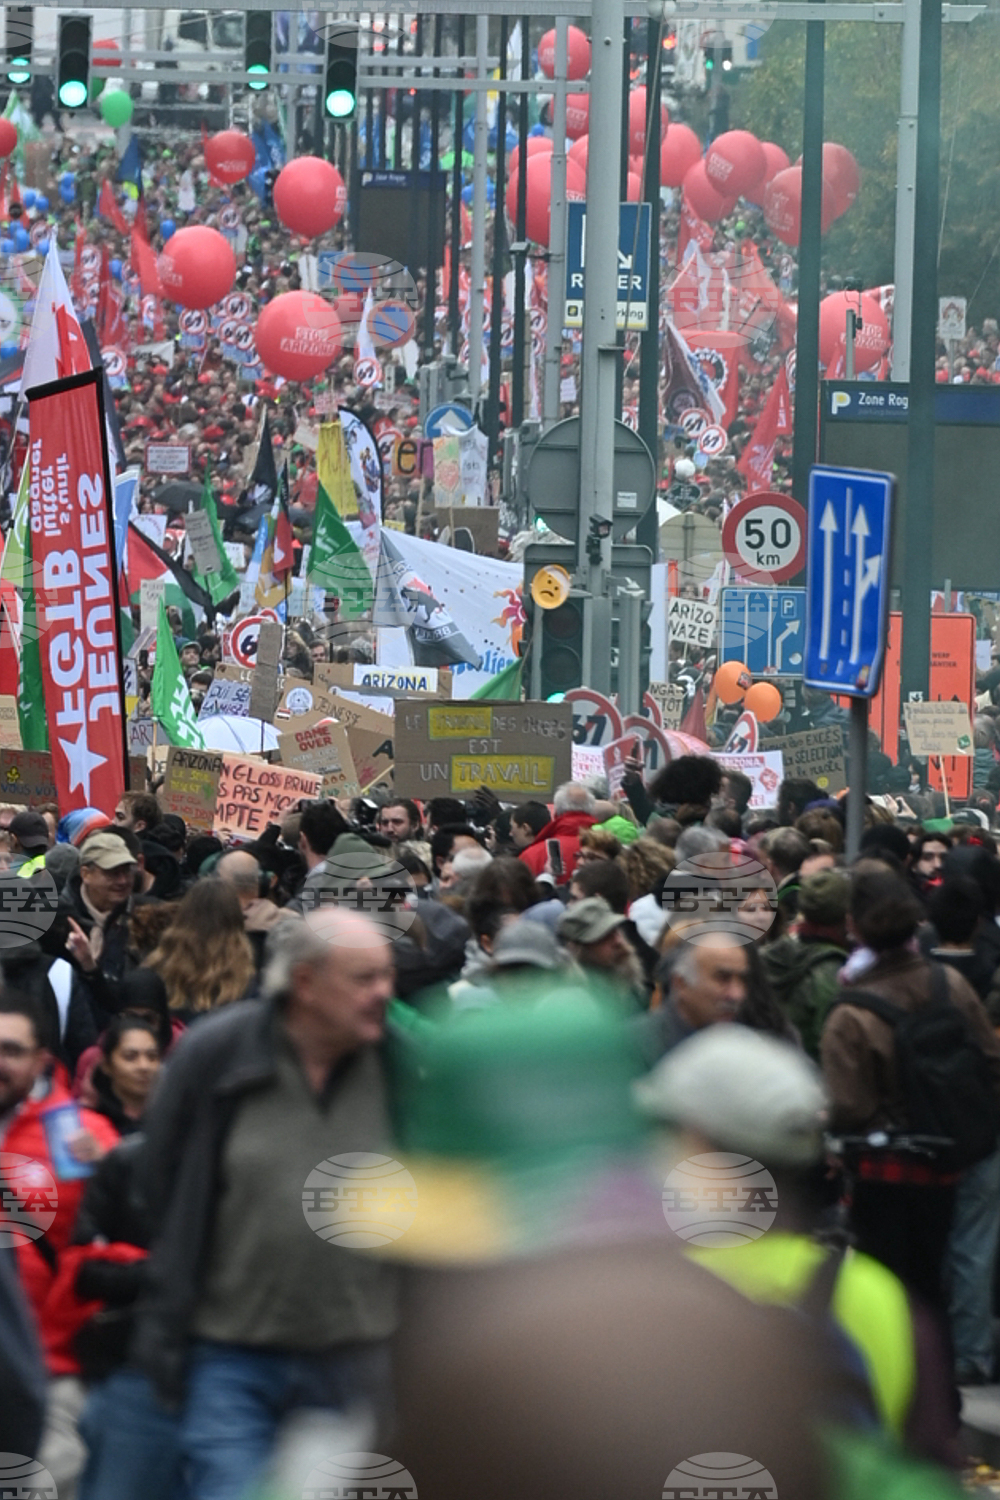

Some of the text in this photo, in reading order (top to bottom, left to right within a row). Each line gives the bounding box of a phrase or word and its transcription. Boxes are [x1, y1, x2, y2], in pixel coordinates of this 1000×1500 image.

[858, 392, 884, 406] Zone
[888, 393, 909, 410] Rog
[745, 518, 791, 549] 50
[757, 552, 780, 565] km
[362, 673, 428, 691] ARIZONA
[295, 726, 331, 743] GAME
[299, 736, 333, 752] OVER
[468, 738, 501, 754] EST
[233, 764, 281, 789] GLOSS
[420, 763, 448, 781] UN
[457, 756, 547, 787] TRAVAIL
[233, 785, 260, 804] PAS
